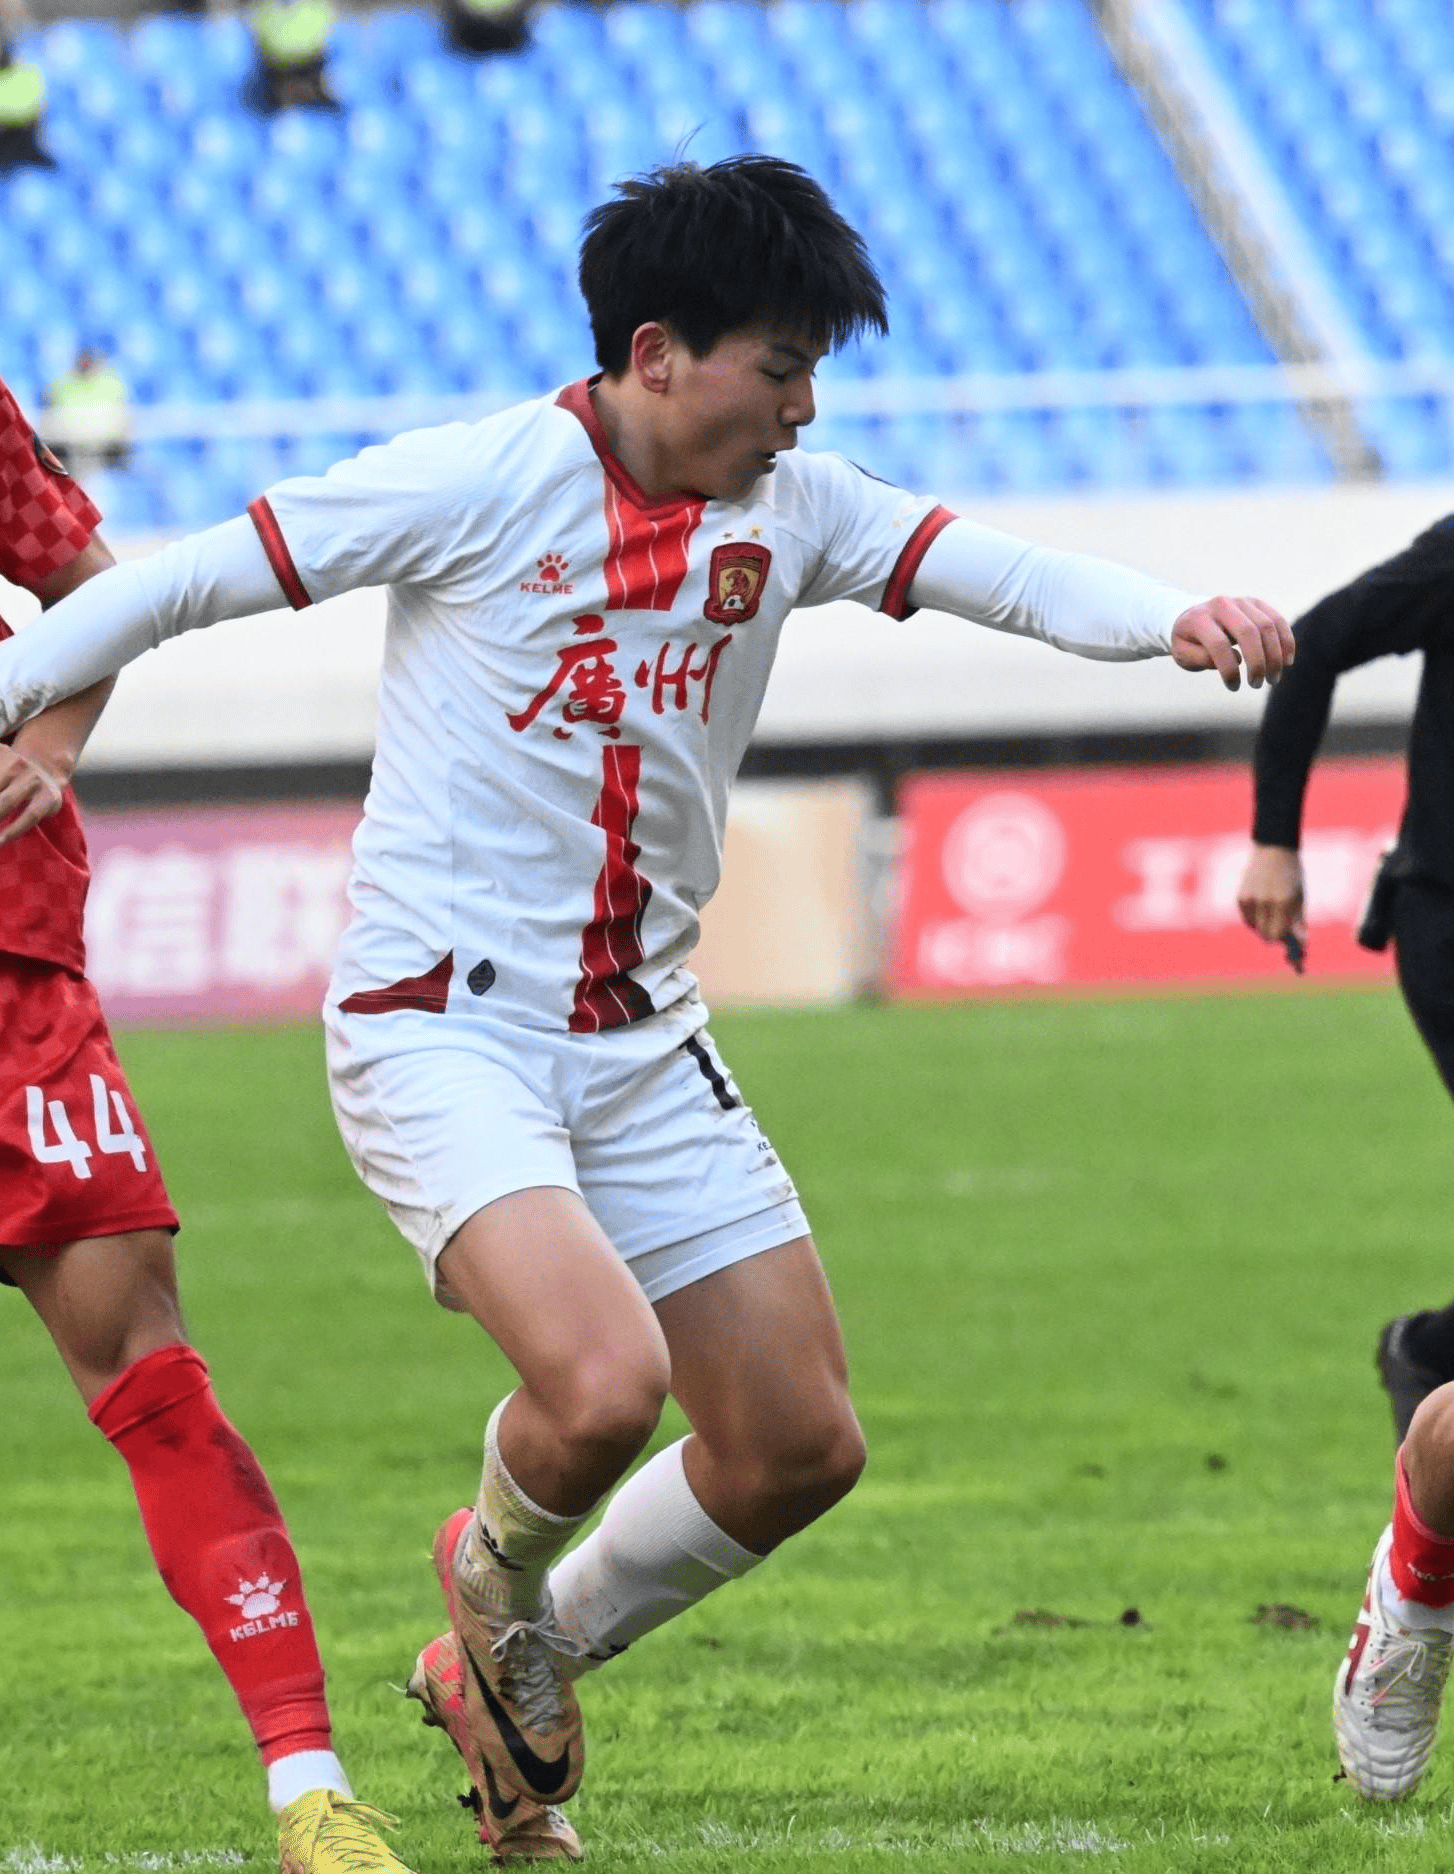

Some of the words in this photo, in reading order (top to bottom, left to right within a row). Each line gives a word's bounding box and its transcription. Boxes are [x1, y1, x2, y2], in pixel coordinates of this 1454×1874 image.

[519, 582, 574, 595] KELME
[506, 613, 733, 740] 廣州
[25, 1073, 148, 1180] 44
[229, 1610, 300, 1642] KELME
